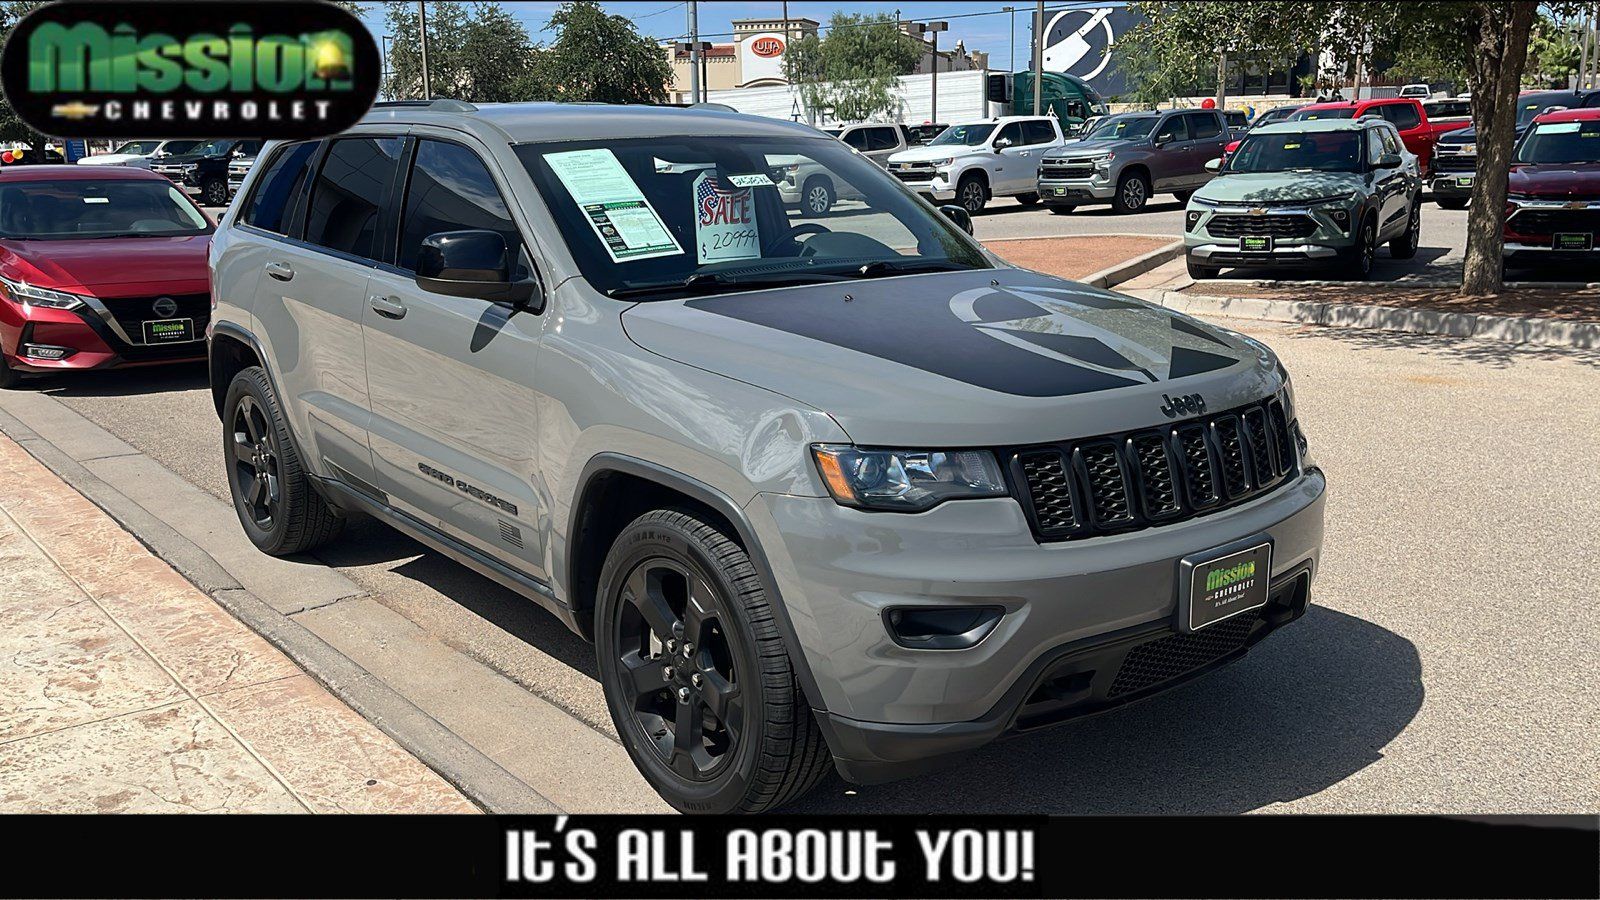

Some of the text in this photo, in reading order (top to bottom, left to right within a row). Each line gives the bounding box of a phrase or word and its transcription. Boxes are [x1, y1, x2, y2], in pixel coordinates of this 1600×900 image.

[757, 41, 780, 52] ULTA
[701, 193, 752, 226] SALE
[1160, 393, 1207, 418] Jeep
[1206, 561, 1255, 591] Mission
[1214, 579, 1254, 599] CHEVROLET
